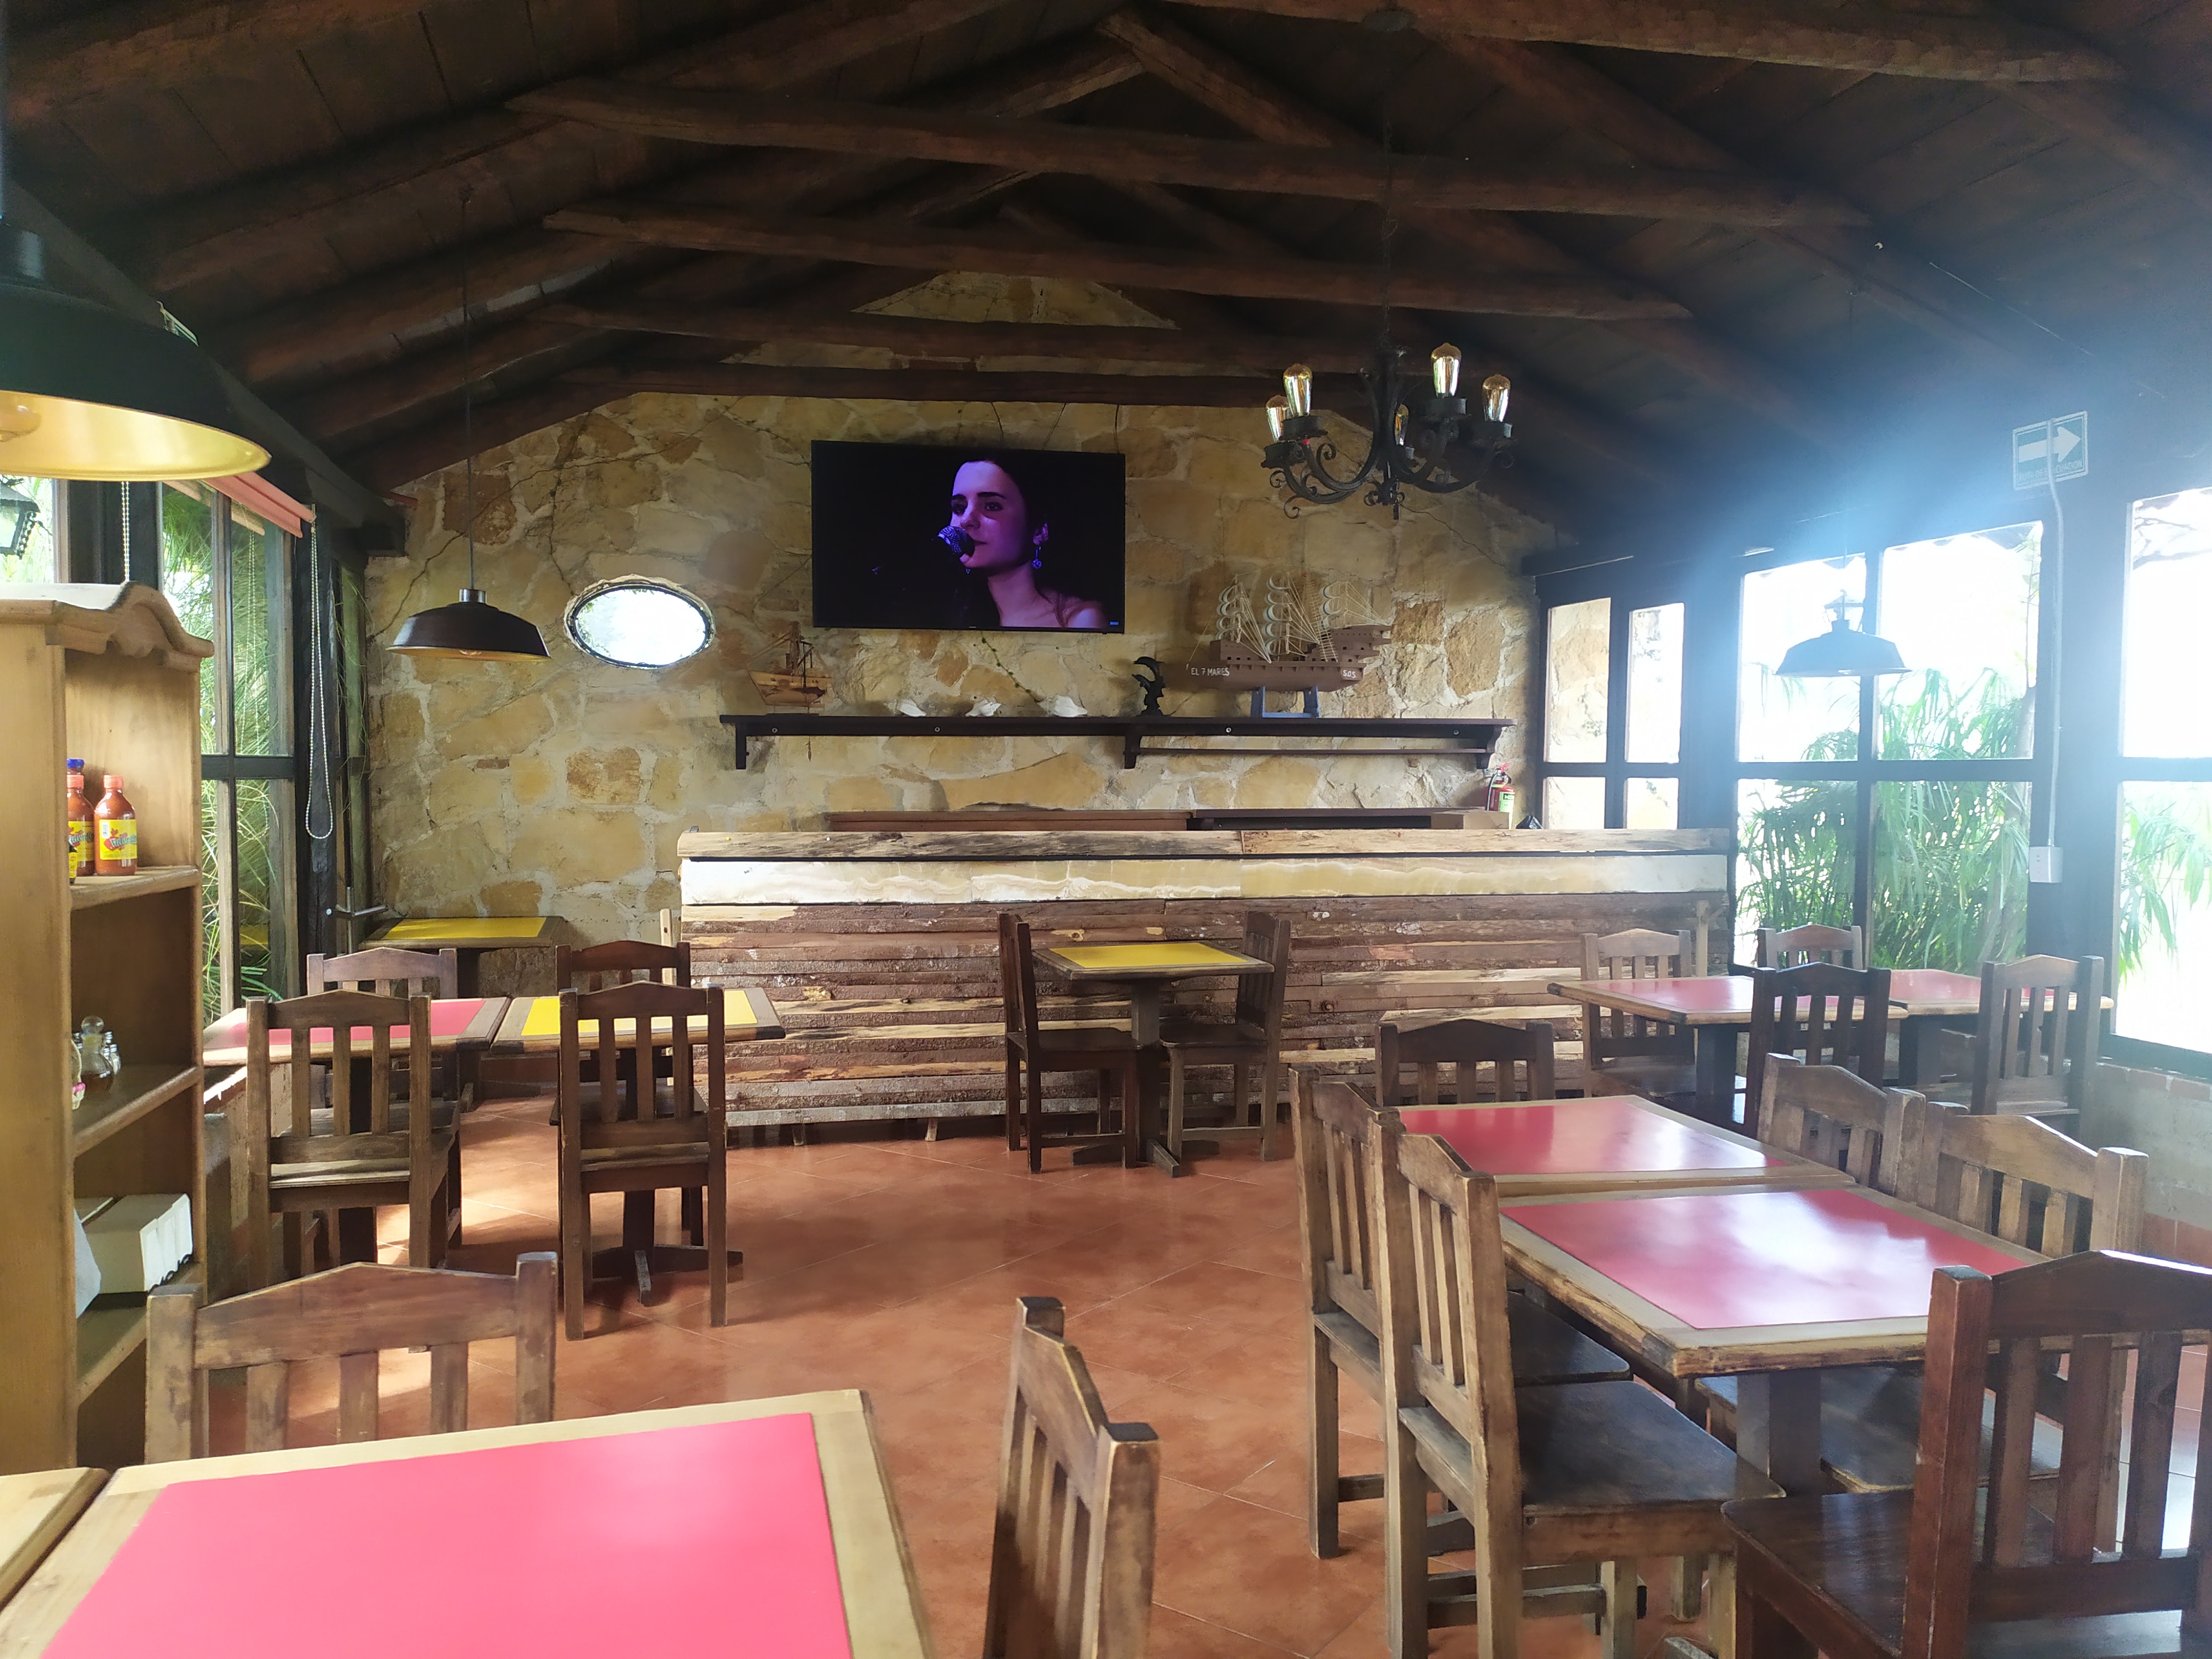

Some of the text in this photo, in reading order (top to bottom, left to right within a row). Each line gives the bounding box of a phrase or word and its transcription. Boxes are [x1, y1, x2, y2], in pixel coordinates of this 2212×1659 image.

[2035, 469, 2044, 478] DE
[1191, 667, 1199, 676] EL
[1207, 667, 1230, 676] MARES
